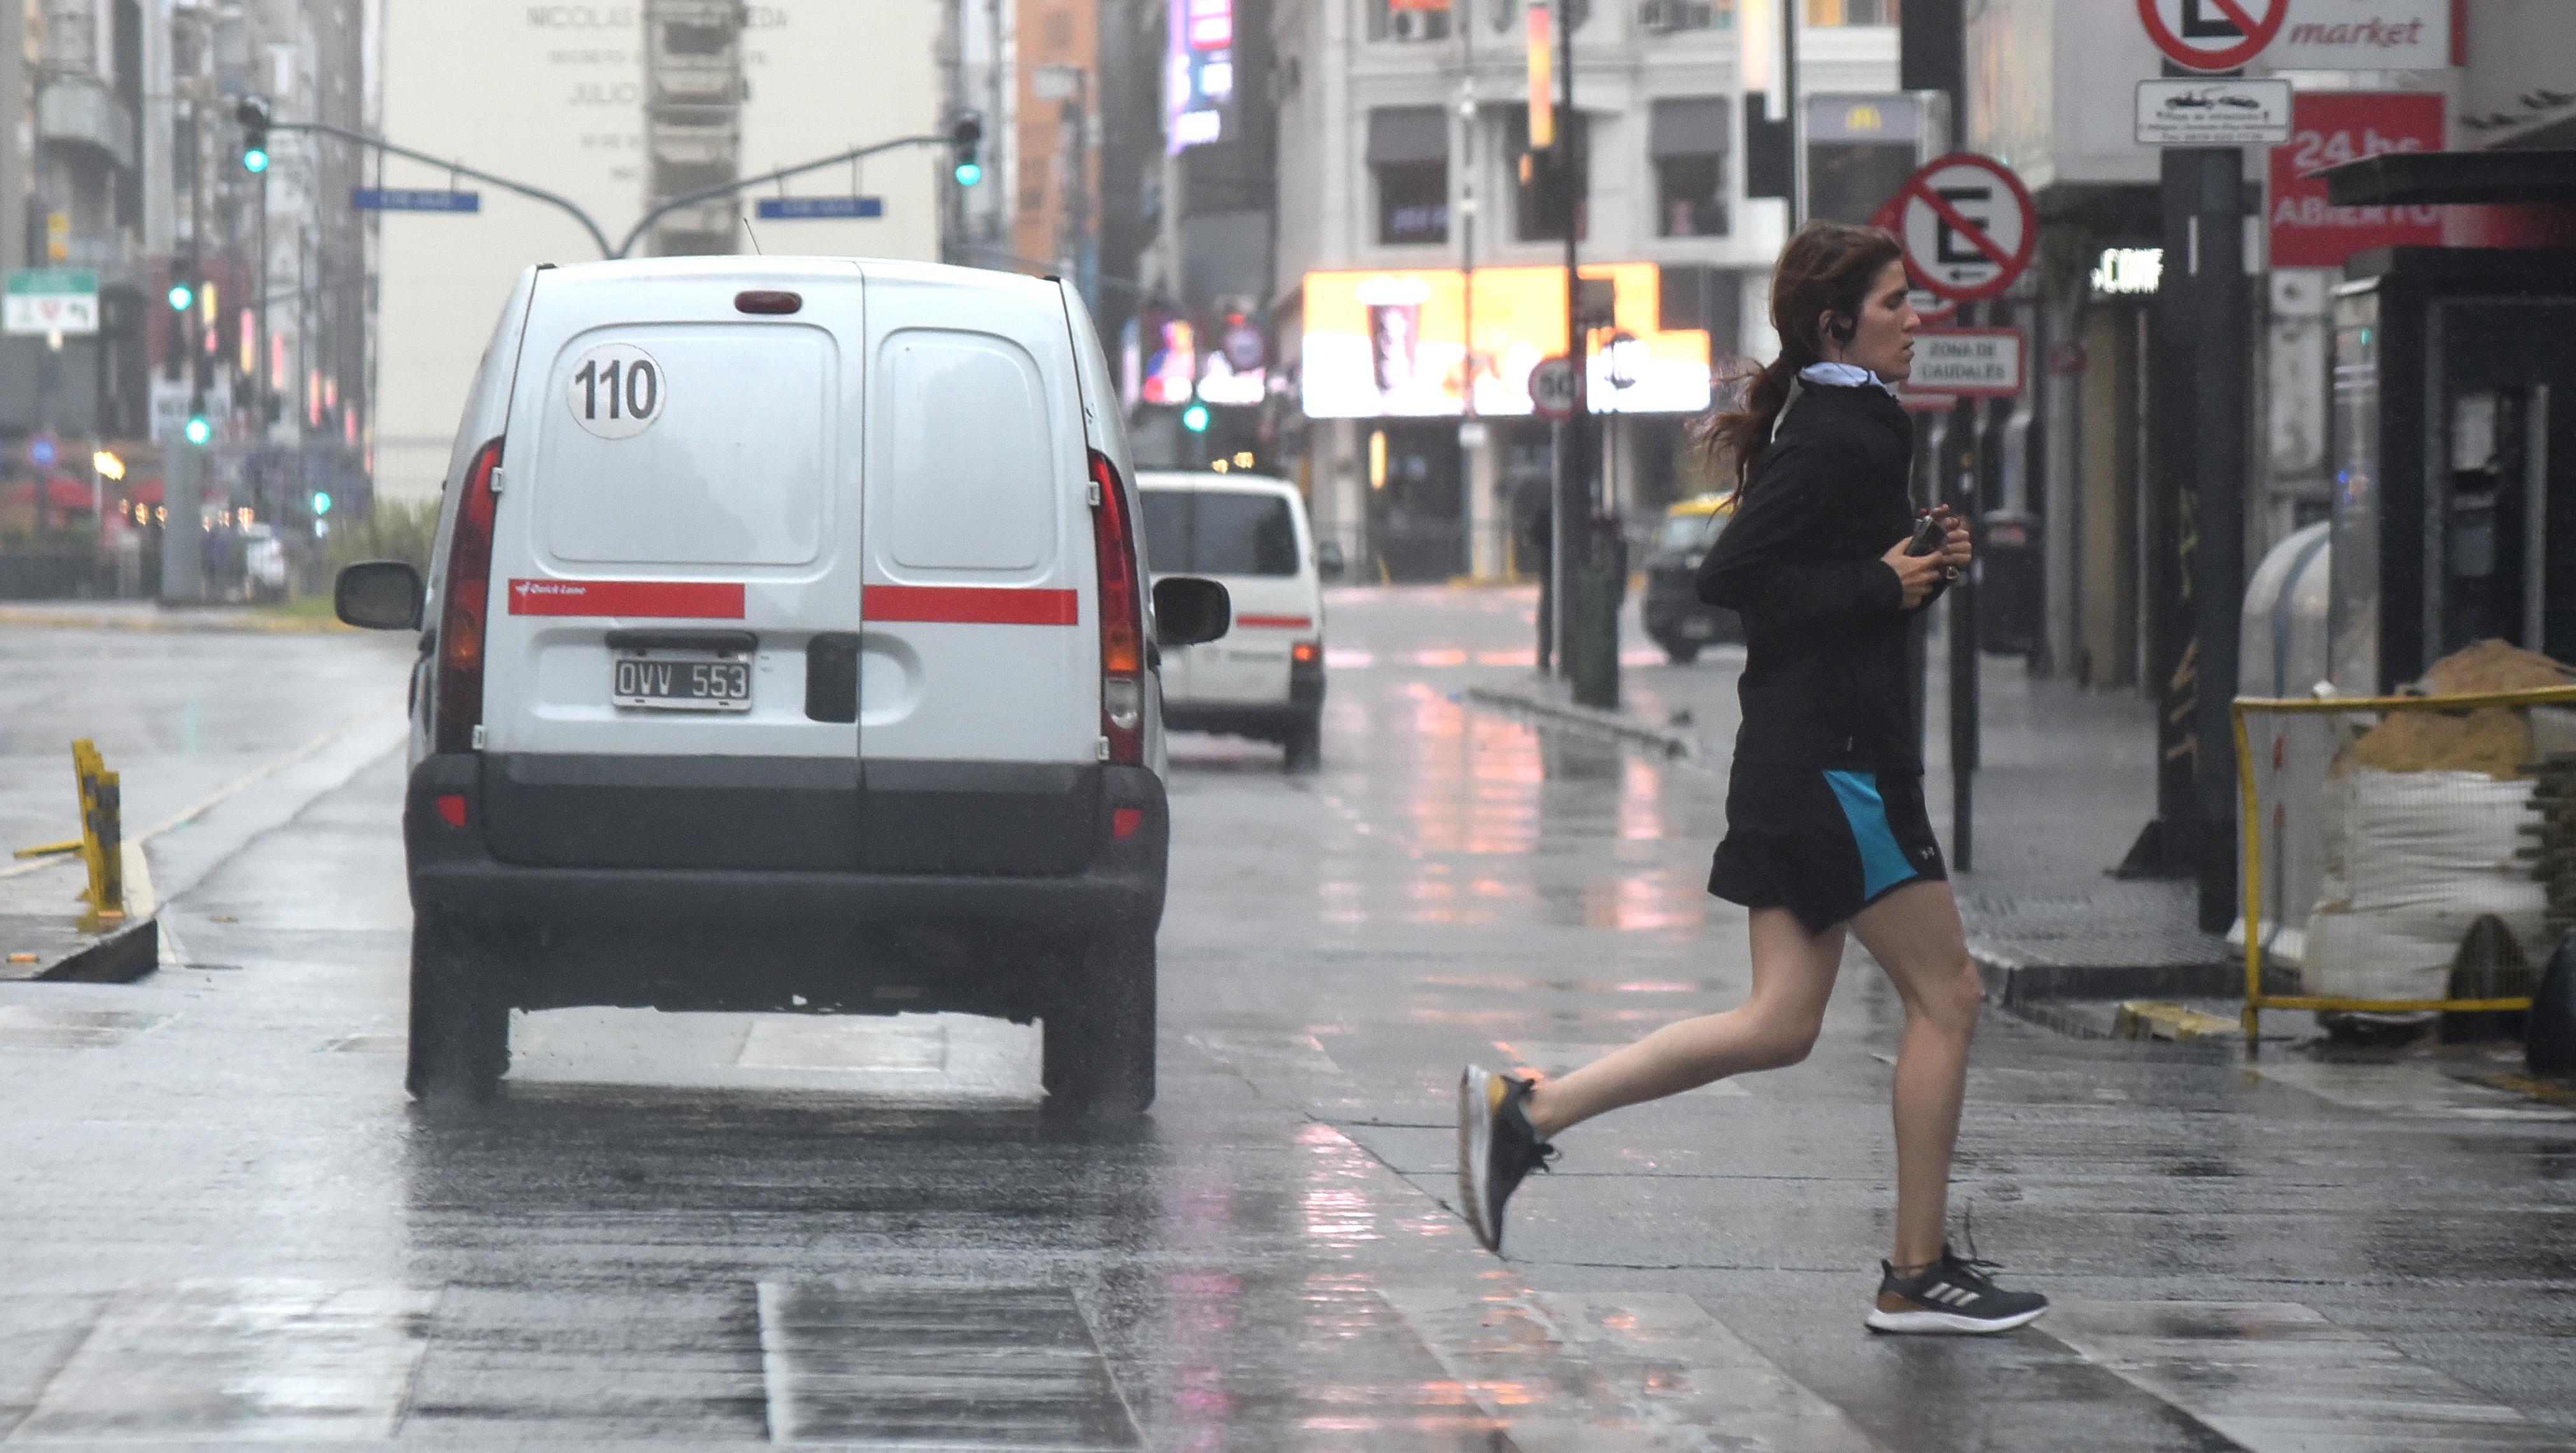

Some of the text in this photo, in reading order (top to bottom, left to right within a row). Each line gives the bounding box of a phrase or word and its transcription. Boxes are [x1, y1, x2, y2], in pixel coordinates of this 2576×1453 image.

[2289, 17, 2423, 48] market
[2293, 130, 2353, 167] 24
[1976, 342, 1996, 356] DE
[575, 360, 657, 420] 110
[529, 583, 586, 595] Quick Lane
[619, 662, 747, 698] OVV 553
